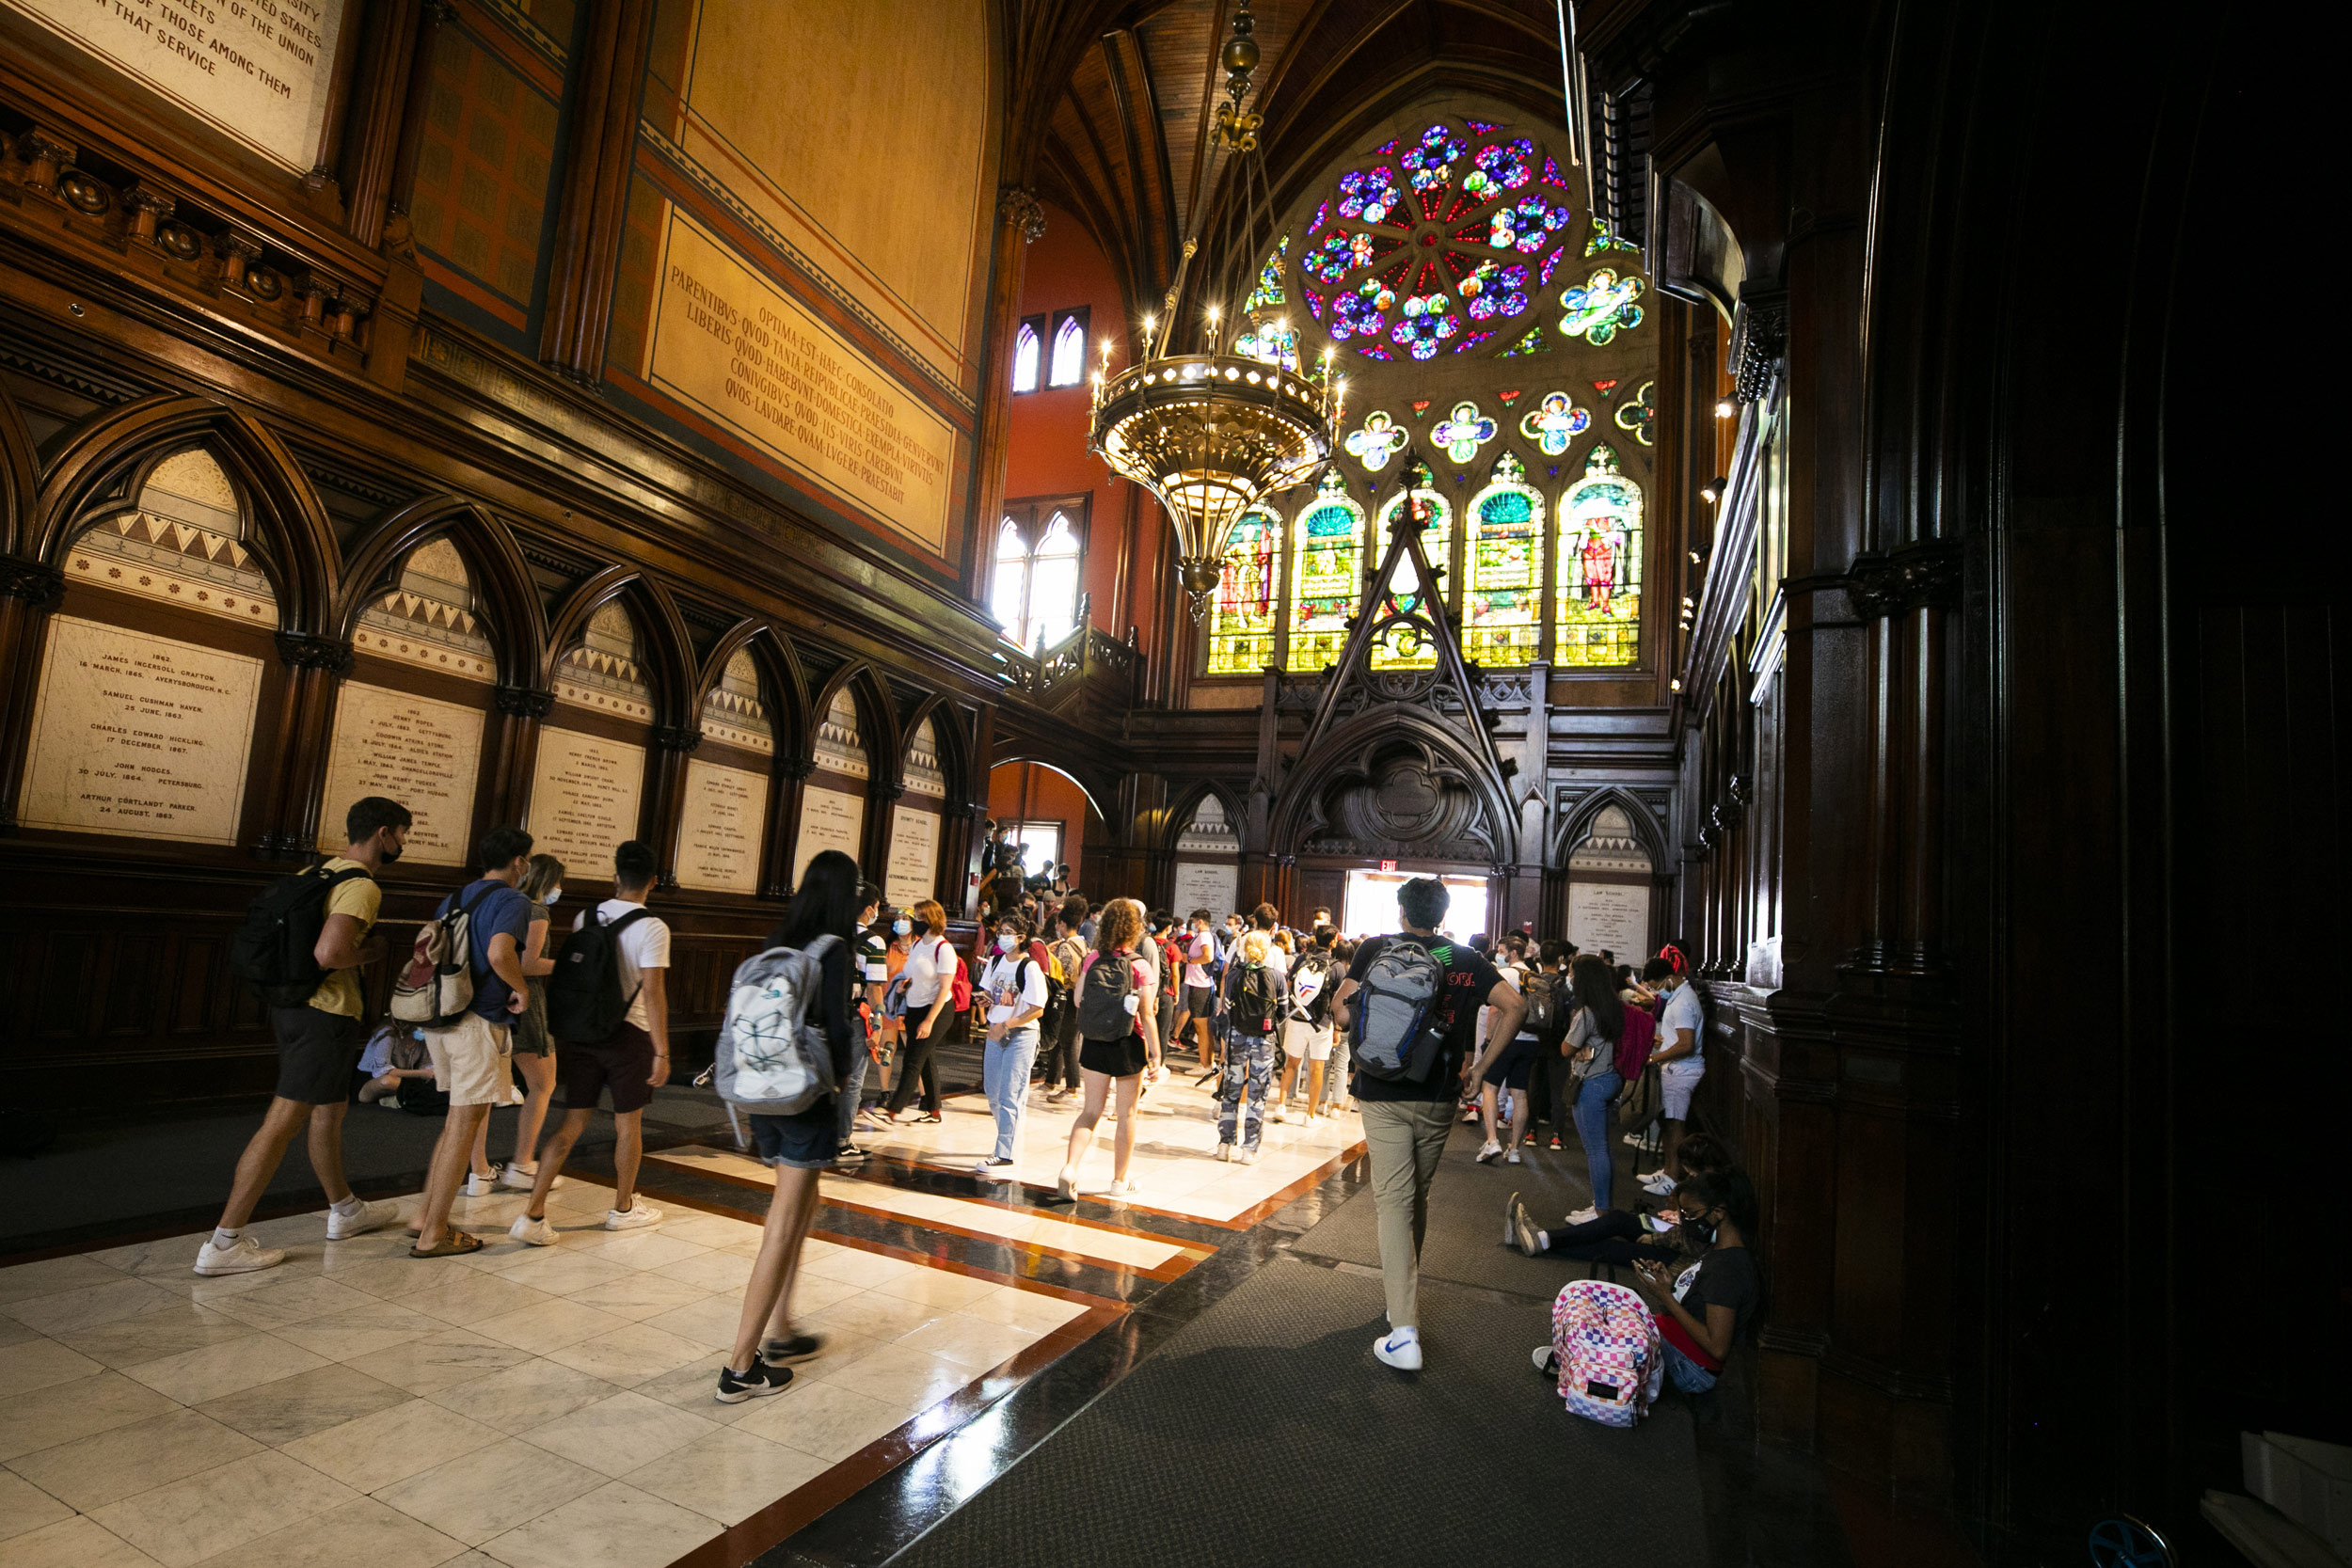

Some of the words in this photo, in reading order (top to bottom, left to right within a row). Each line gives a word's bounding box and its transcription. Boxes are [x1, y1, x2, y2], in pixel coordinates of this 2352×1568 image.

[176, 0, 215, 24] LETS
[114, 0, 153, 34] THAT
[157, 29, 216, 76] SERVICE
[231, 1, 247, 19] OF
[251, 14, 274, 40] THE
[278, 33, 314, 67] UNION
[280, 12, 321, 48] STATES
[160, 4, 205, 44] THOSE
[209, 39, 254, 75] AMONG
[259, 68, 291, 99] THEM
[742, 317, 769, 348] QVOD
[774, 339, 800, 372] TANTA
[759, 307, 796, 347] OPTIMA
[800, 336, 817, 360] EST
[819, 352, 843, 380] HAEC
[687, 301, 732, 345] LIBERIS
[735, 336, 762, 366] QVOD
[766, 357, 815, 402] HABEBVNT
[866, 428, 900, 463] EXEMPLA
[903, 453, 934, 485] VIRTVTIS
[725, 378, 751, 406] QVOS
[755, 396, 795, 435] LAVDARE
[798, 425, 823, 453] QVAM
[826, 443, 858, 476] LVGERE
[795, 401, 818, 427] QVOD
[823, 419, 835, 439] IIS
[840, 430, 862, 457] VIRIS
[866, 449, 904, 484] CAREBVNT
[93, 663, 123, 675] MARCH,
[155, 676, 216, 692] AVERYSBOROUGH,
[102, 655, 128, 663] JAMES
[134, 661, 175, 673] INGERSOLL
[102, 690, 134, 701] SAMUEL
[140, 697, 174, 707] CUSHMAN
[180, 704, 203, 713] HAVEN.
[91, 724, 127, 734] CHARLES
[133, 730, 164, 739] EDWARD
[169, 736, 206, 747] HICKLING.
[158, 779, 204, 789] PETERSBURG.
[80, 793, 112, 802] ARTHUR
[118, 798, 164, 808] CORTLANDT
[117, 808, 151, 817] AUGUST,
[1382, 861, 1397, 872] EXIT
